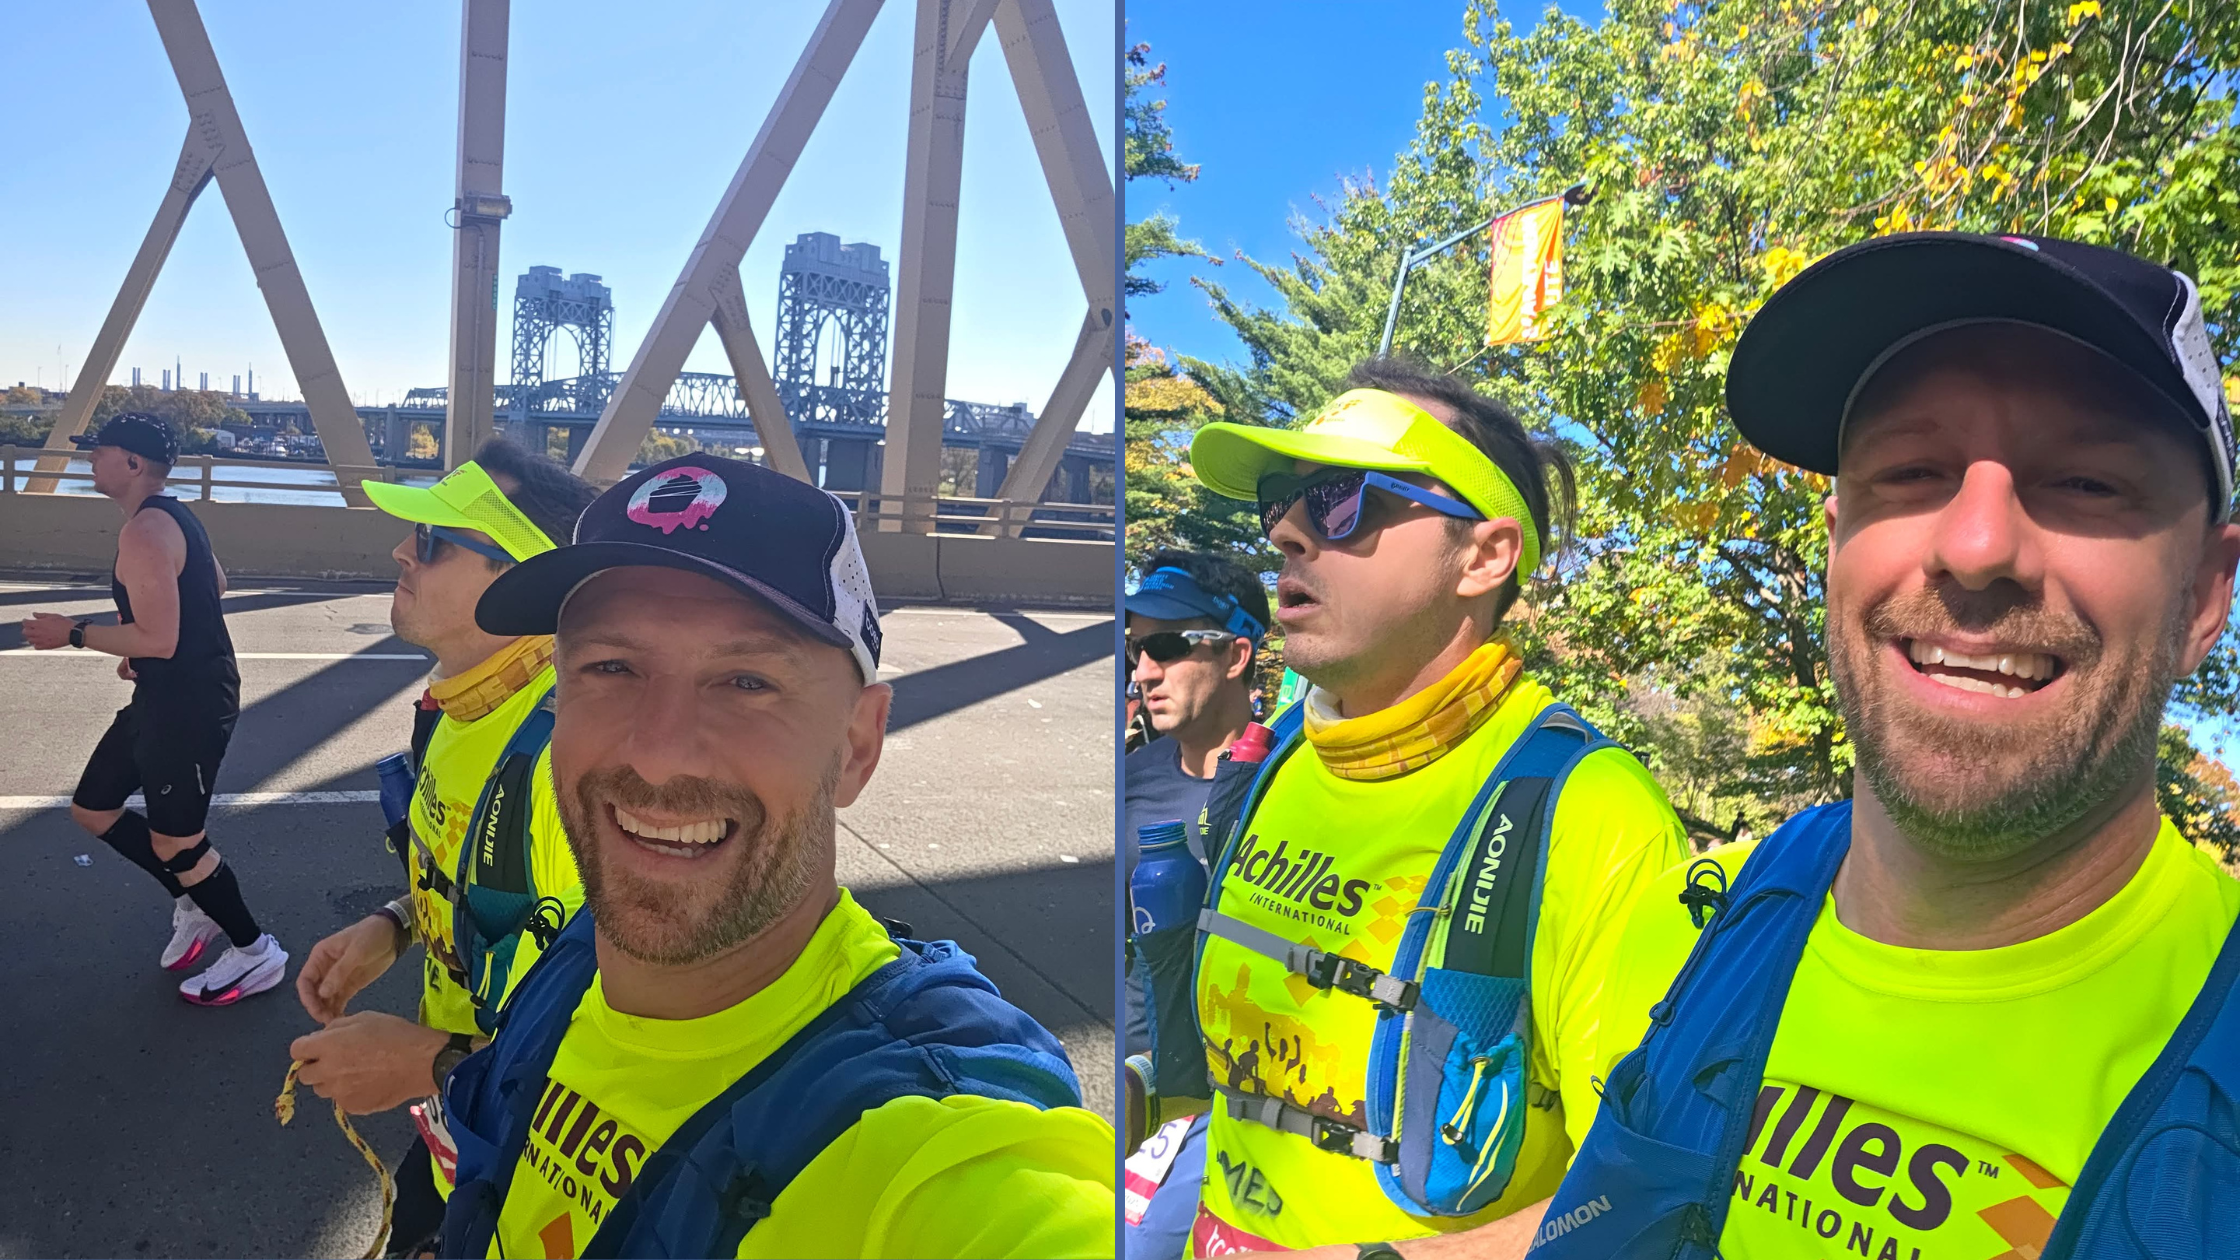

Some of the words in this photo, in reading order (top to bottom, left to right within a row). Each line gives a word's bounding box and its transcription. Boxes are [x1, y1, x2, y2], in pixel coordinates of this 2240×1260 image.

[483, 784, 505, 867] AONIJIE
[1233, 833, 1371, 917] Achilles
[1249, 892, 1350, 935] INTERNATIONAL
[1464, 813, 1513, 935] AONIJIE
